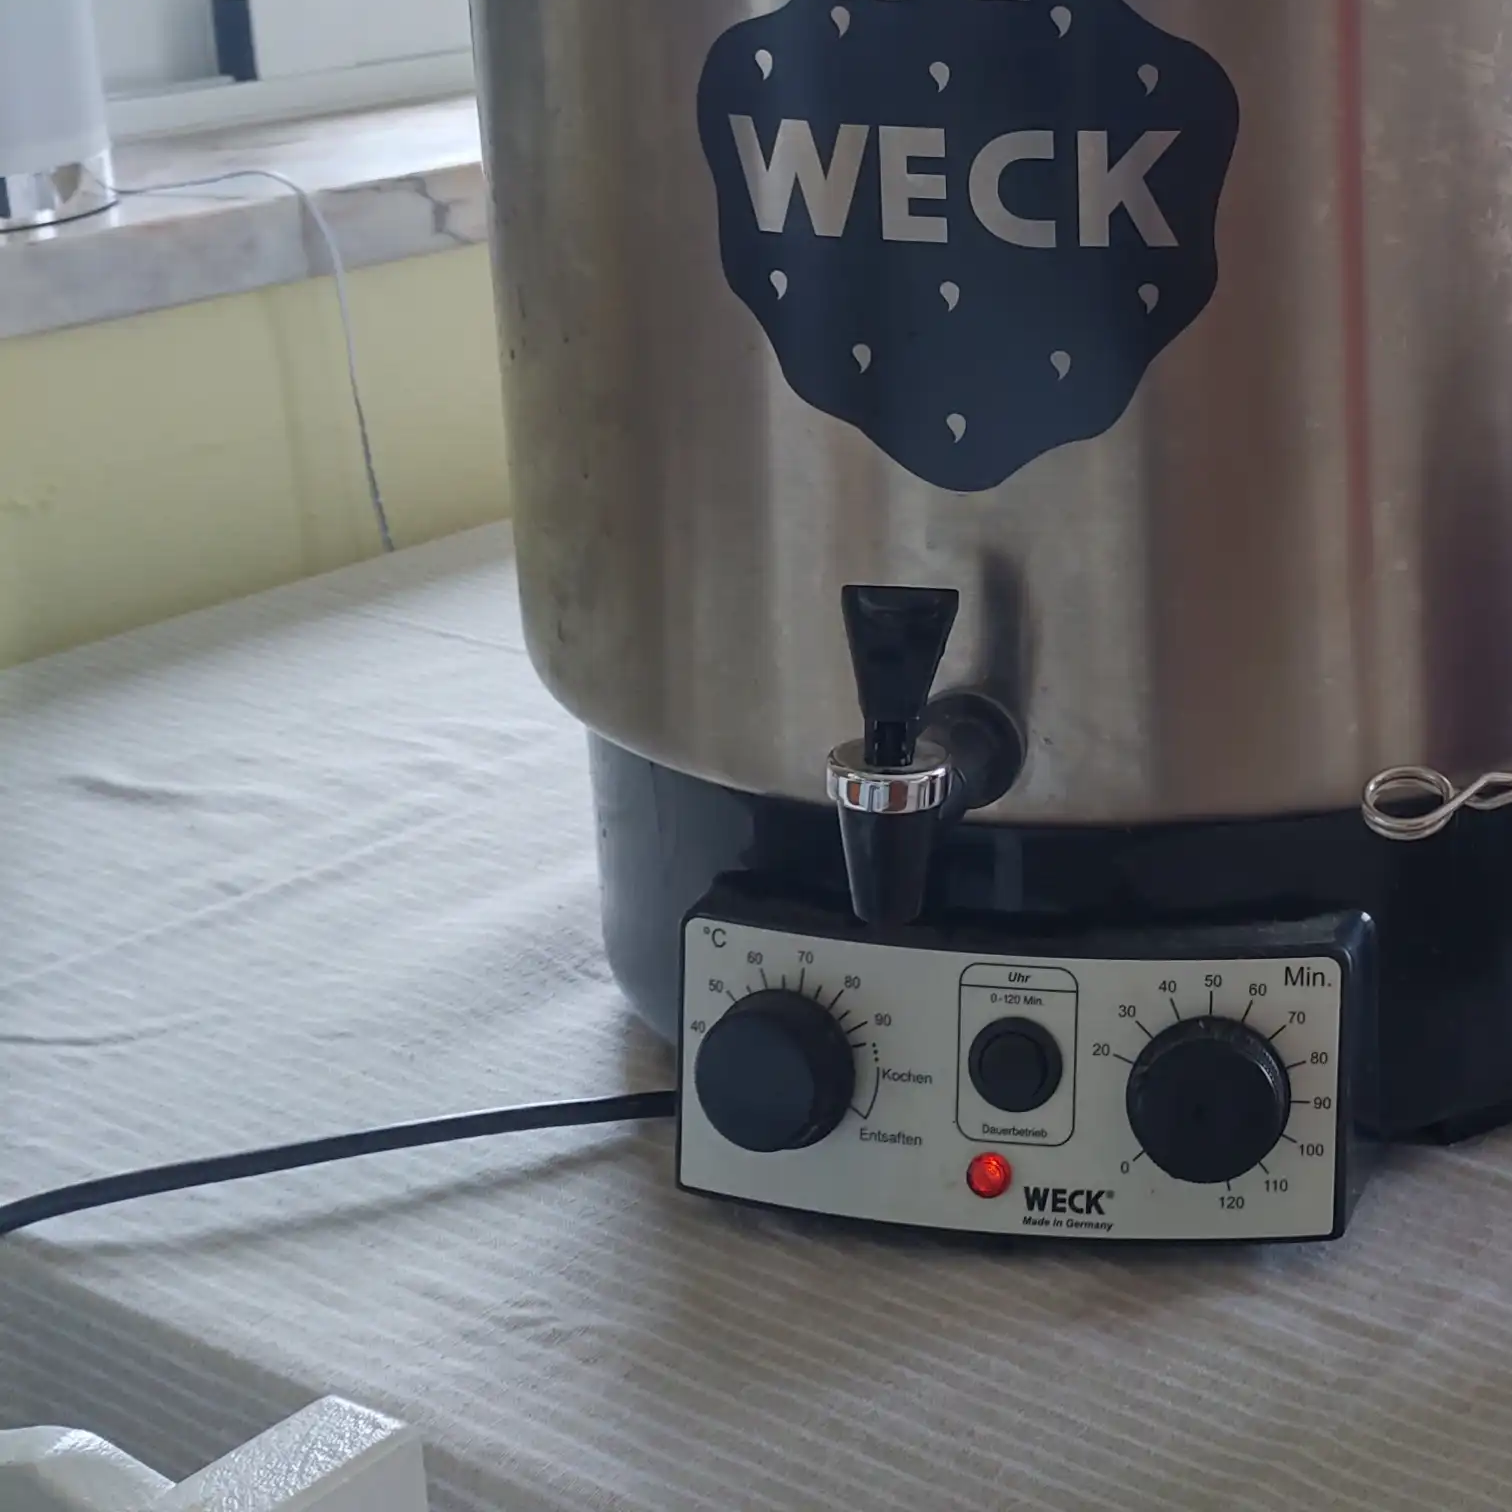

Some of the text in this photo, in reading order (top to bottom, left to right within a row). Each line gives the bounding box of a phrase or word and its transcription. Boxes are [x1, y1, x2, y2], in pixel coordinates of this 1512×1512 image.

[726, 113, 1182, 248] WECK
[747, 951, 763, 965] 60
[797, 950, 814, 964] 70
[844, 975, 861, 989] 80
[1008, 971, 1031, 983] Uhr
[1204, 974, 1222, 988] 50
[1284, 965, 1332, 987] Min.
[708, 979, 724, 993] 50
[1158, 980, 1177, 993] 40
[1248, 983, 1267, 996] 60
[1118, 1004, 1136, 1018] 30
[1288, 1010, 1306, 1024] 70
[690, 1019, 706, 1033] 40
[874, 1013, 892, 1027] 90
[1092, 1043, 1110, 1056] 20
[1310, 1051, 1328, 1064] 80
[882, 1068, 933, 1085] Kochen
[1313, 1096, 1332, 1109] 90
[859, 1127, 923, 1147] Entsaften
[982, 1123, 1048, 1138] Dauerbetrieb
[1298, 1143, 1324, 1157] 100
[1120, 1161, 1130, 1175] 0
[1264, 1179, 1288, 1192] 110
[1219, 1196, 1245, 1209] 120
[1022, 1216, 1114, 1233] Made in Germany
